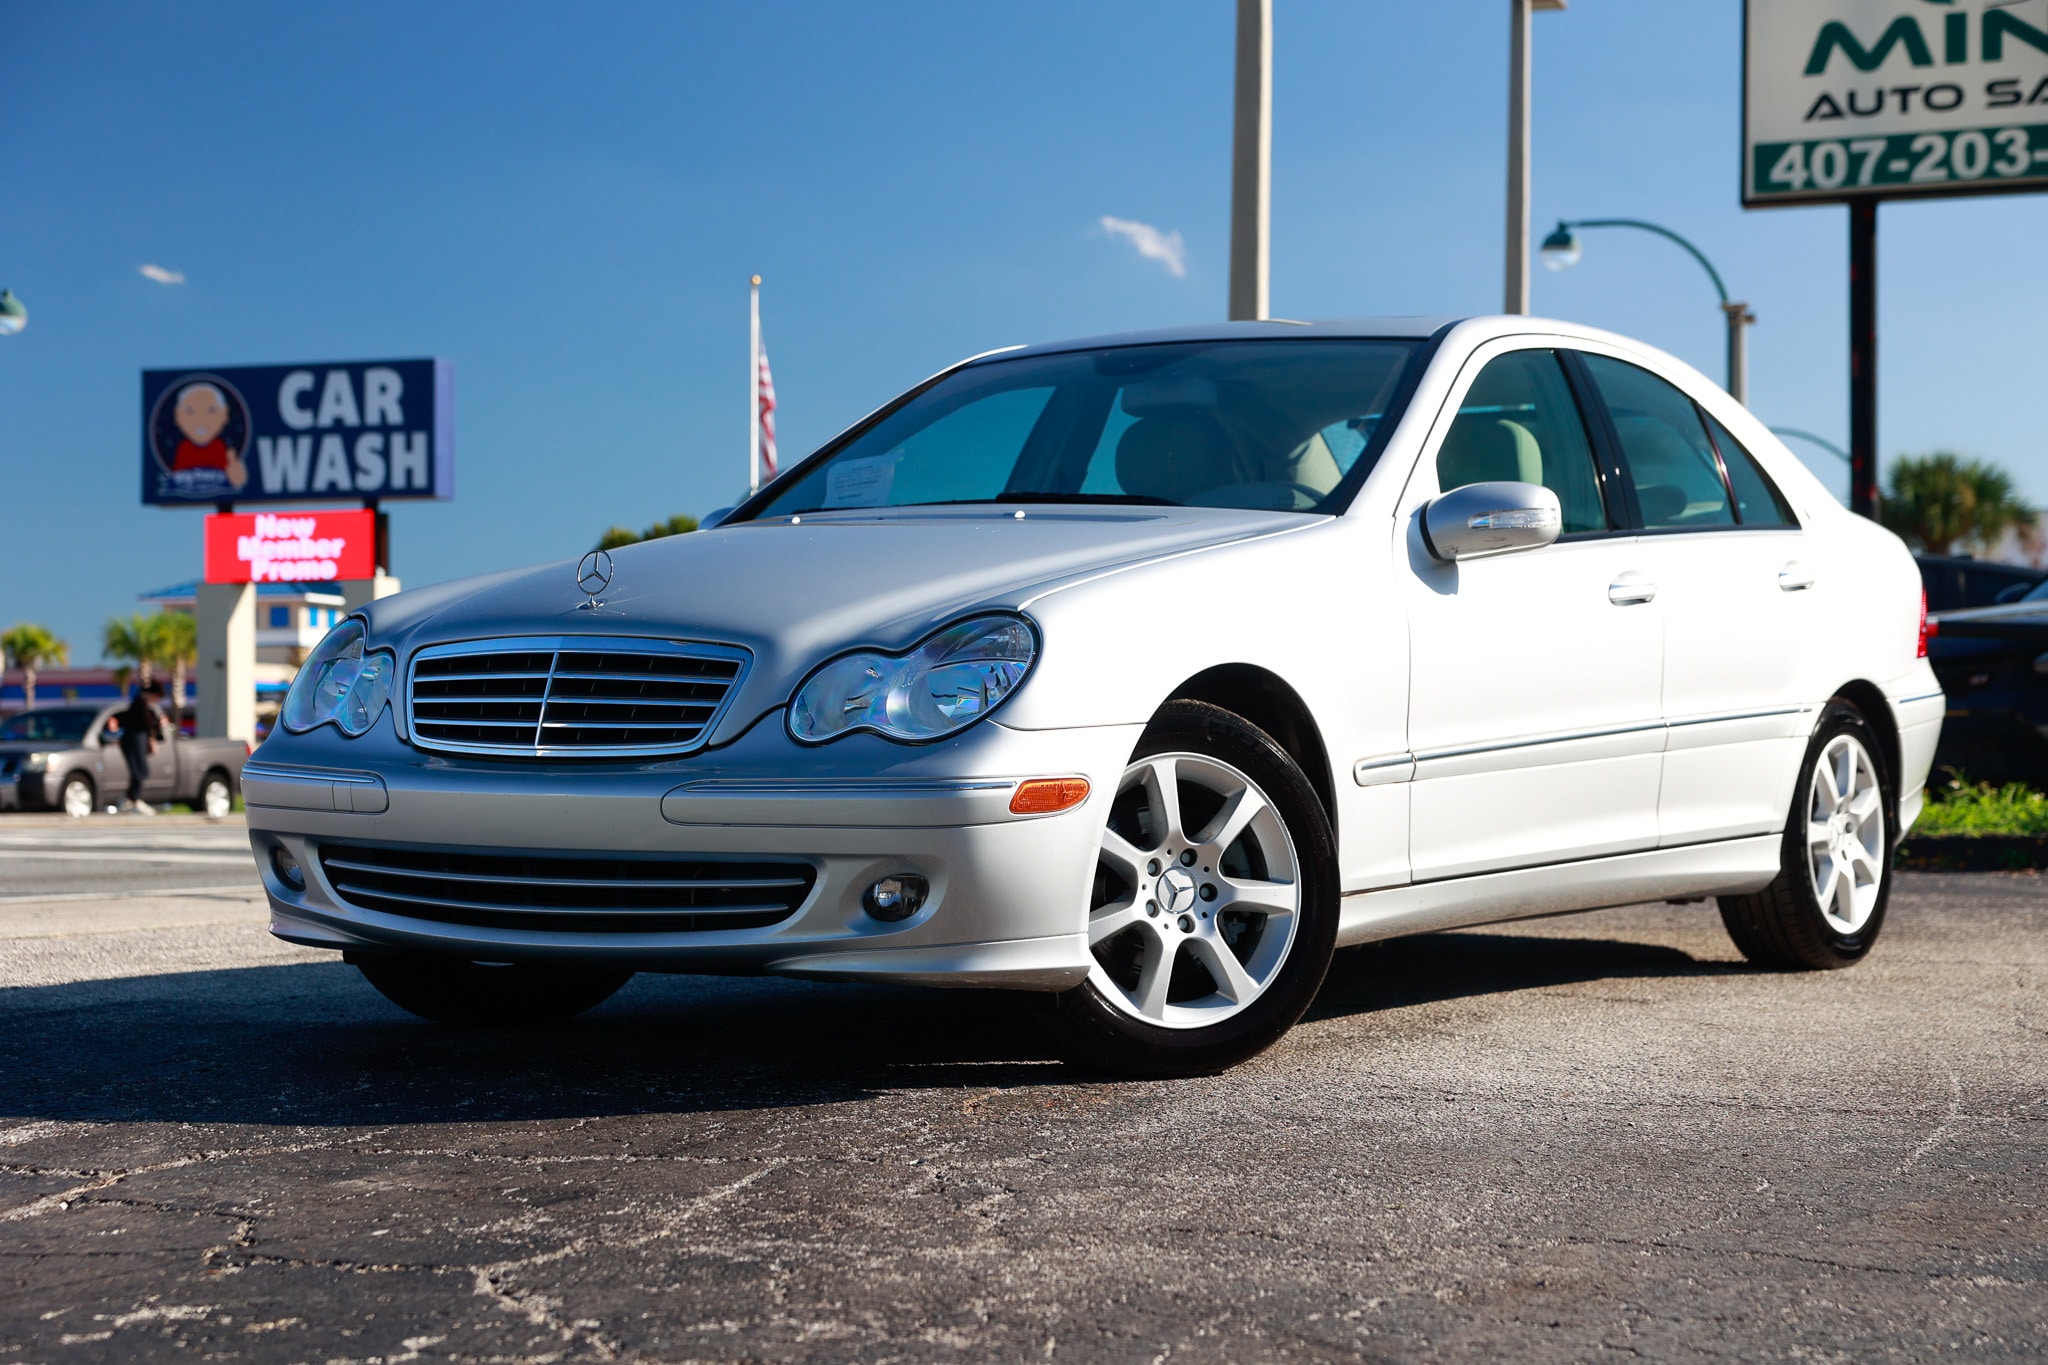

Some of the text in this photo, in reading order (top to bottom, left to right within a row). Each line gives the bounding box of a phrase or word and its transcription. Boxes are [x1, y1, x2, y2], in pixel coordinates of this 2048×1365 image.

[1802, 8, 2048, 76] MIN
[1803, 84, 1964, 122] AUTO
[1769, 128, 2048, 190] 407-203-
[277, 367, 404, 430] CAR
[257, 431, 429, 494] WASH
[237, 535, 346, 561] Member
[255, 513, 317, 539] New
[251, 558, 338, 582] Promo
